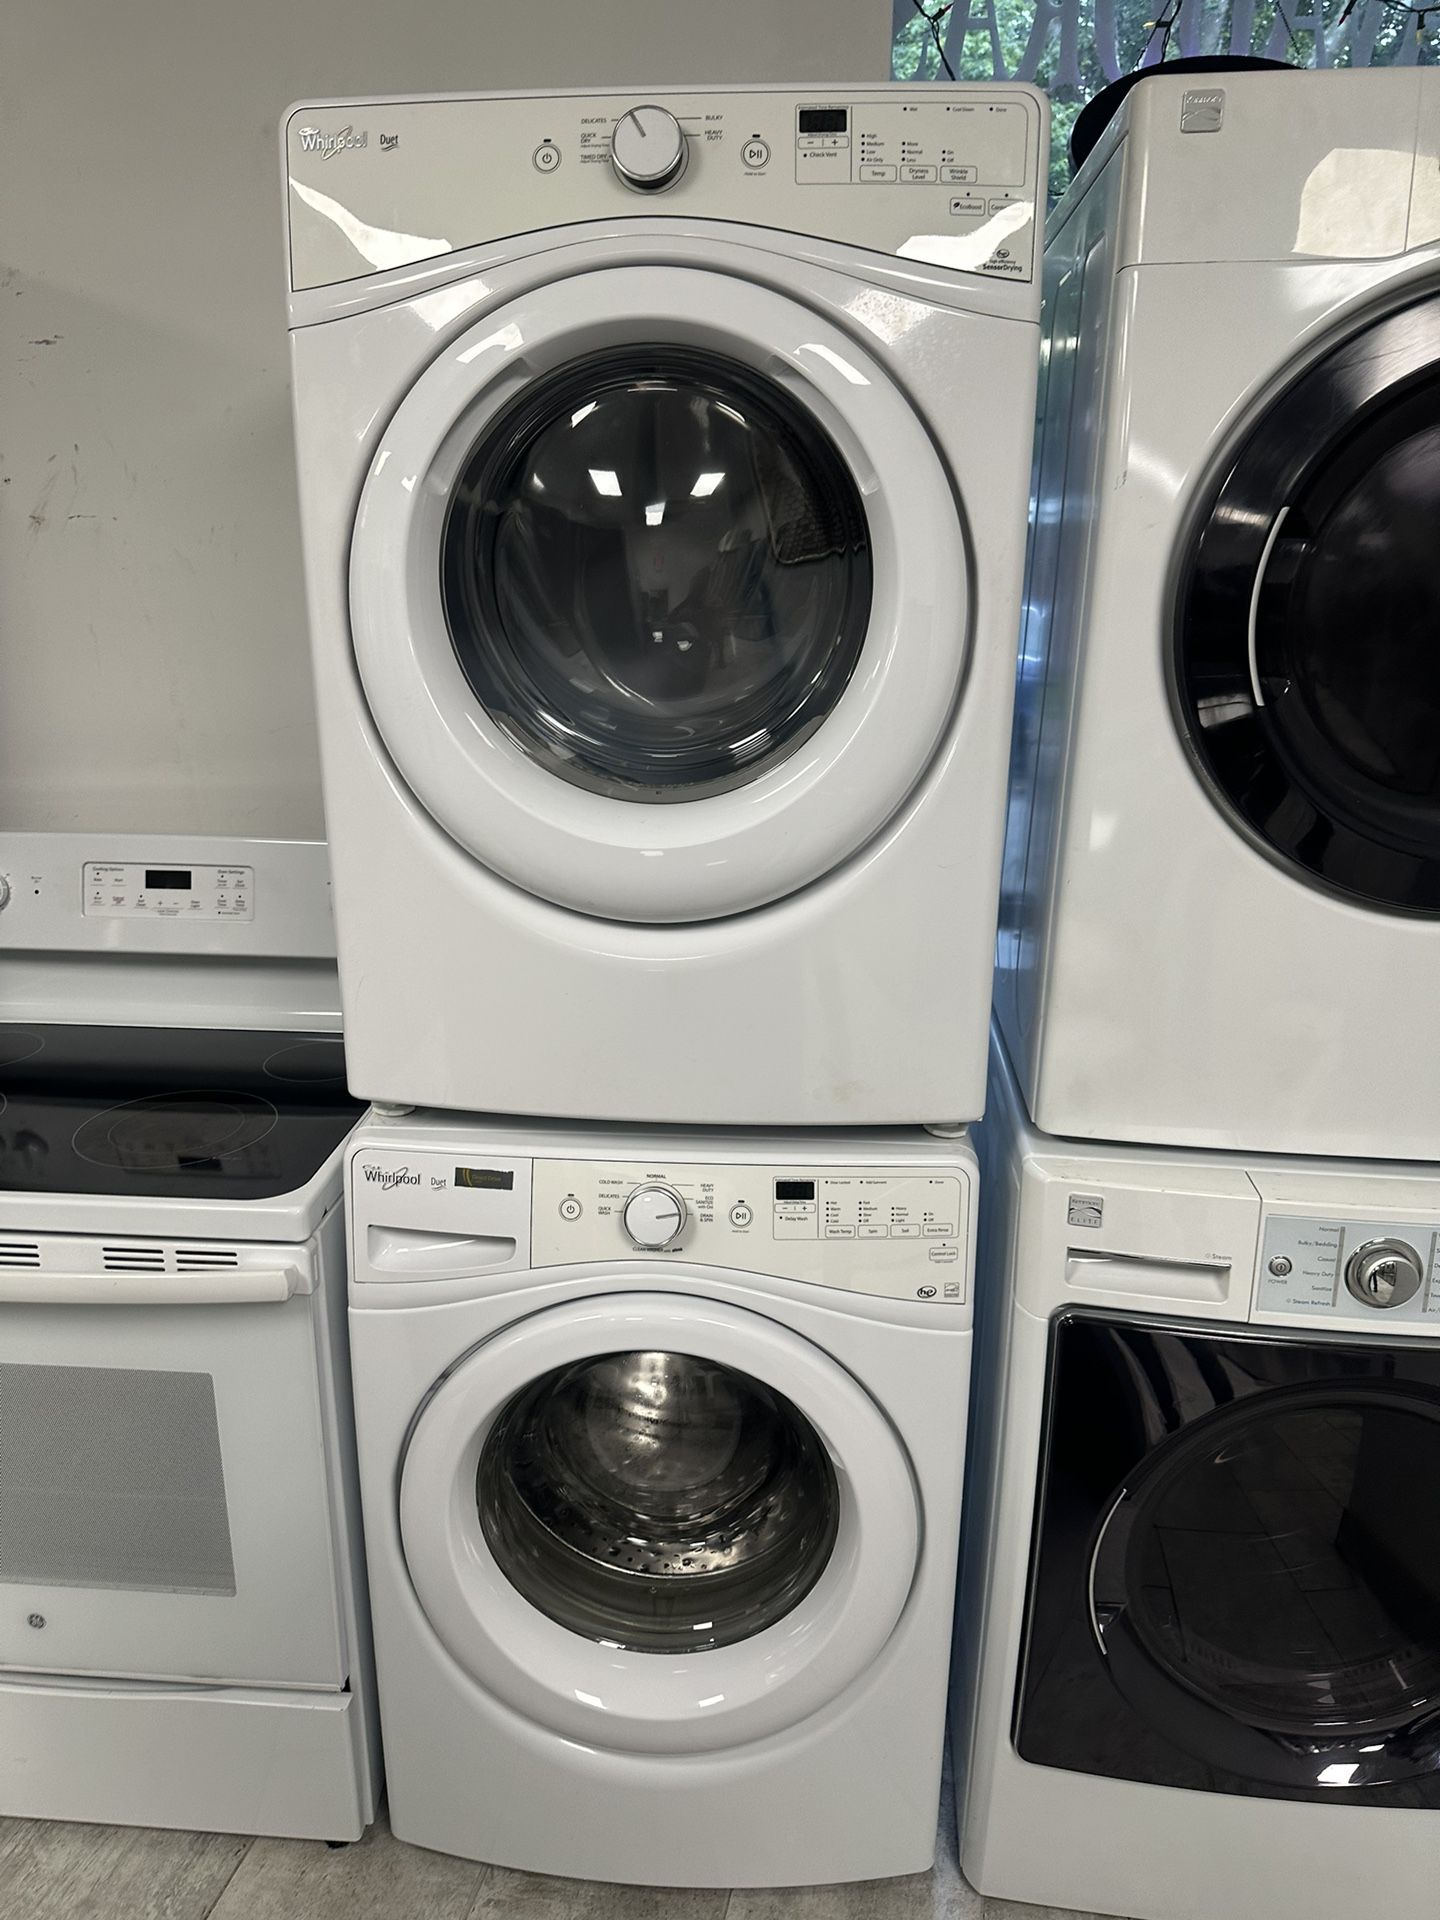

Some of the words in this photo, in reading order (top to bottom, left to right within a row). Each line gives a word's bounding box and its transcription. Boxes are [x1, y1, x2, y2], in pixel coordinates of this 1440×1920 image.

[299, 128, 369, 159] Whirlpool
[379, 133, 399, 150] Duet
[982, 263, 1023, 272] SensorDrying
[364, 1167, 421, 1189] Whirlpool
[430, 1177, 447, 1190] Duet
[1070, 1217, 1098, 1225] ELITE
